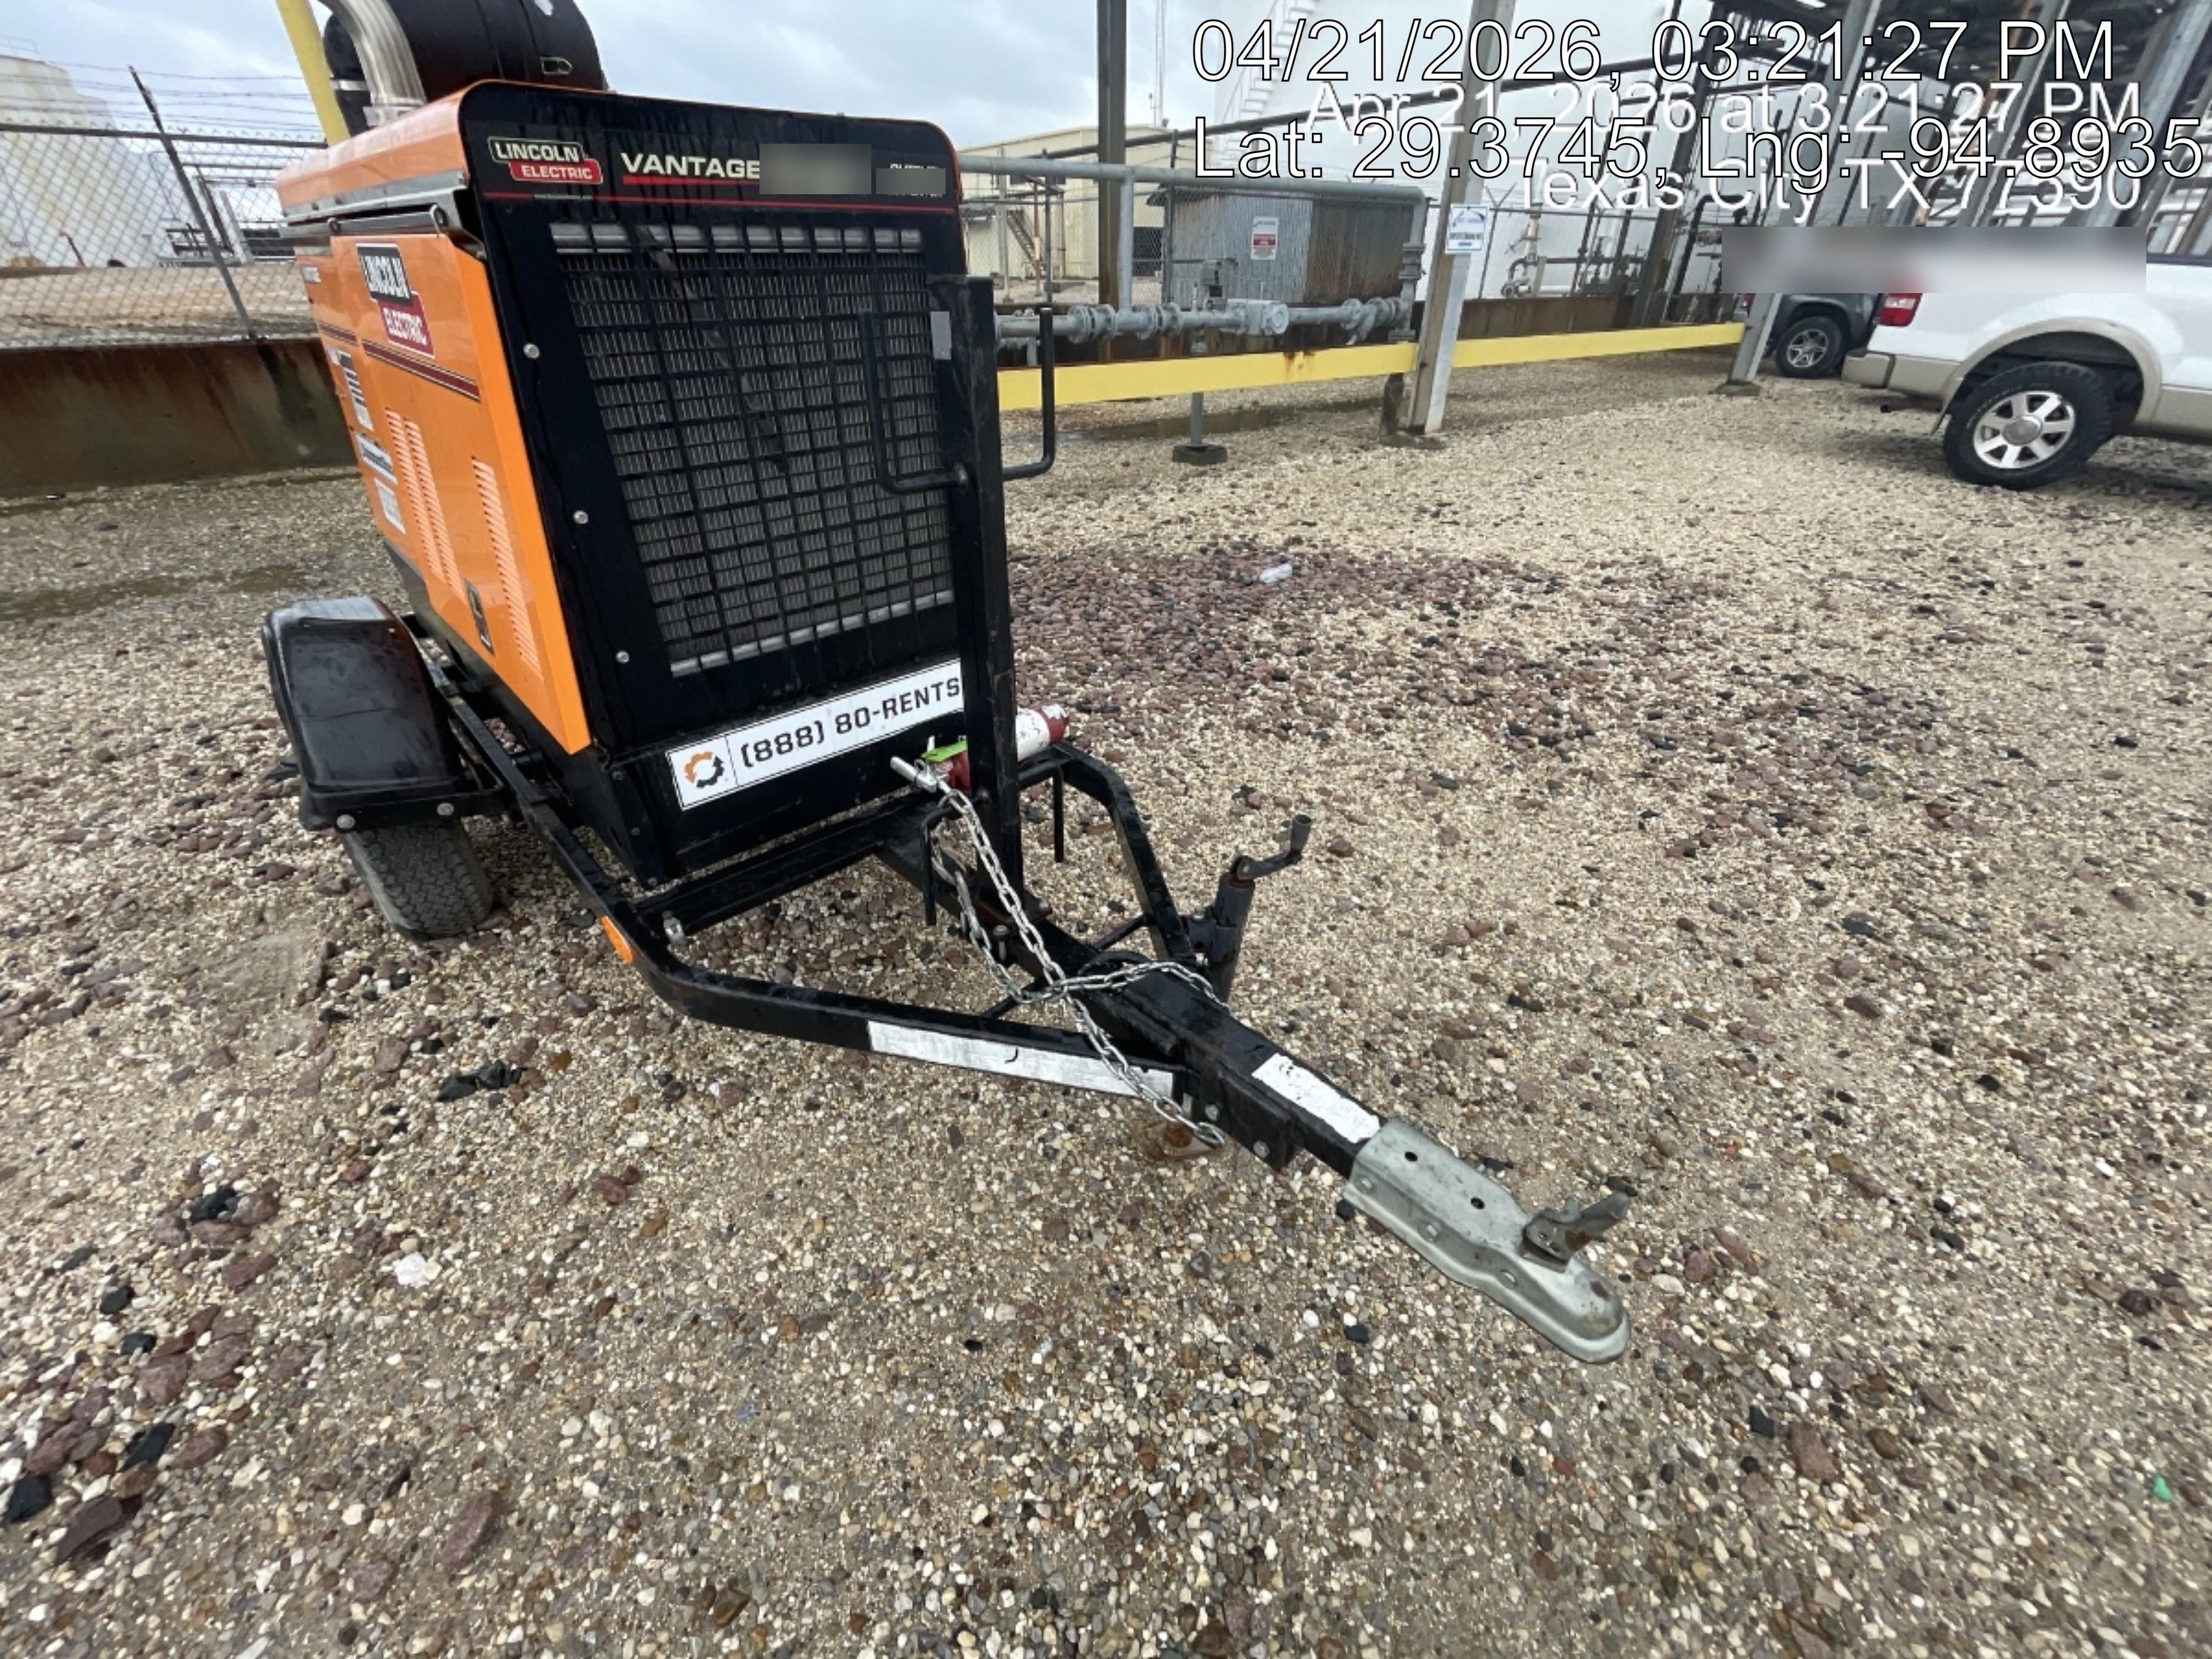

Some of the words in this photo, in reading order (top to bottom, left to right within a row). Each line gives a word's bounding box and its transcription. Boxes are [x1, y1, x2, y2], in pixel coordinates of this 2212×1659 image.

[495, 143, 579, 162] LINCOLN
[621, 152, 760, 179] VANTAGE
[521, 165, 592, 180] ELECTRIC
[359, 256, 410, 299] LINCOLN
[383, 307, 427, 345] ELECTRIC
[741, 720, 825, 768] (888)
[835, 677, 960, 735] 80-RENTS
